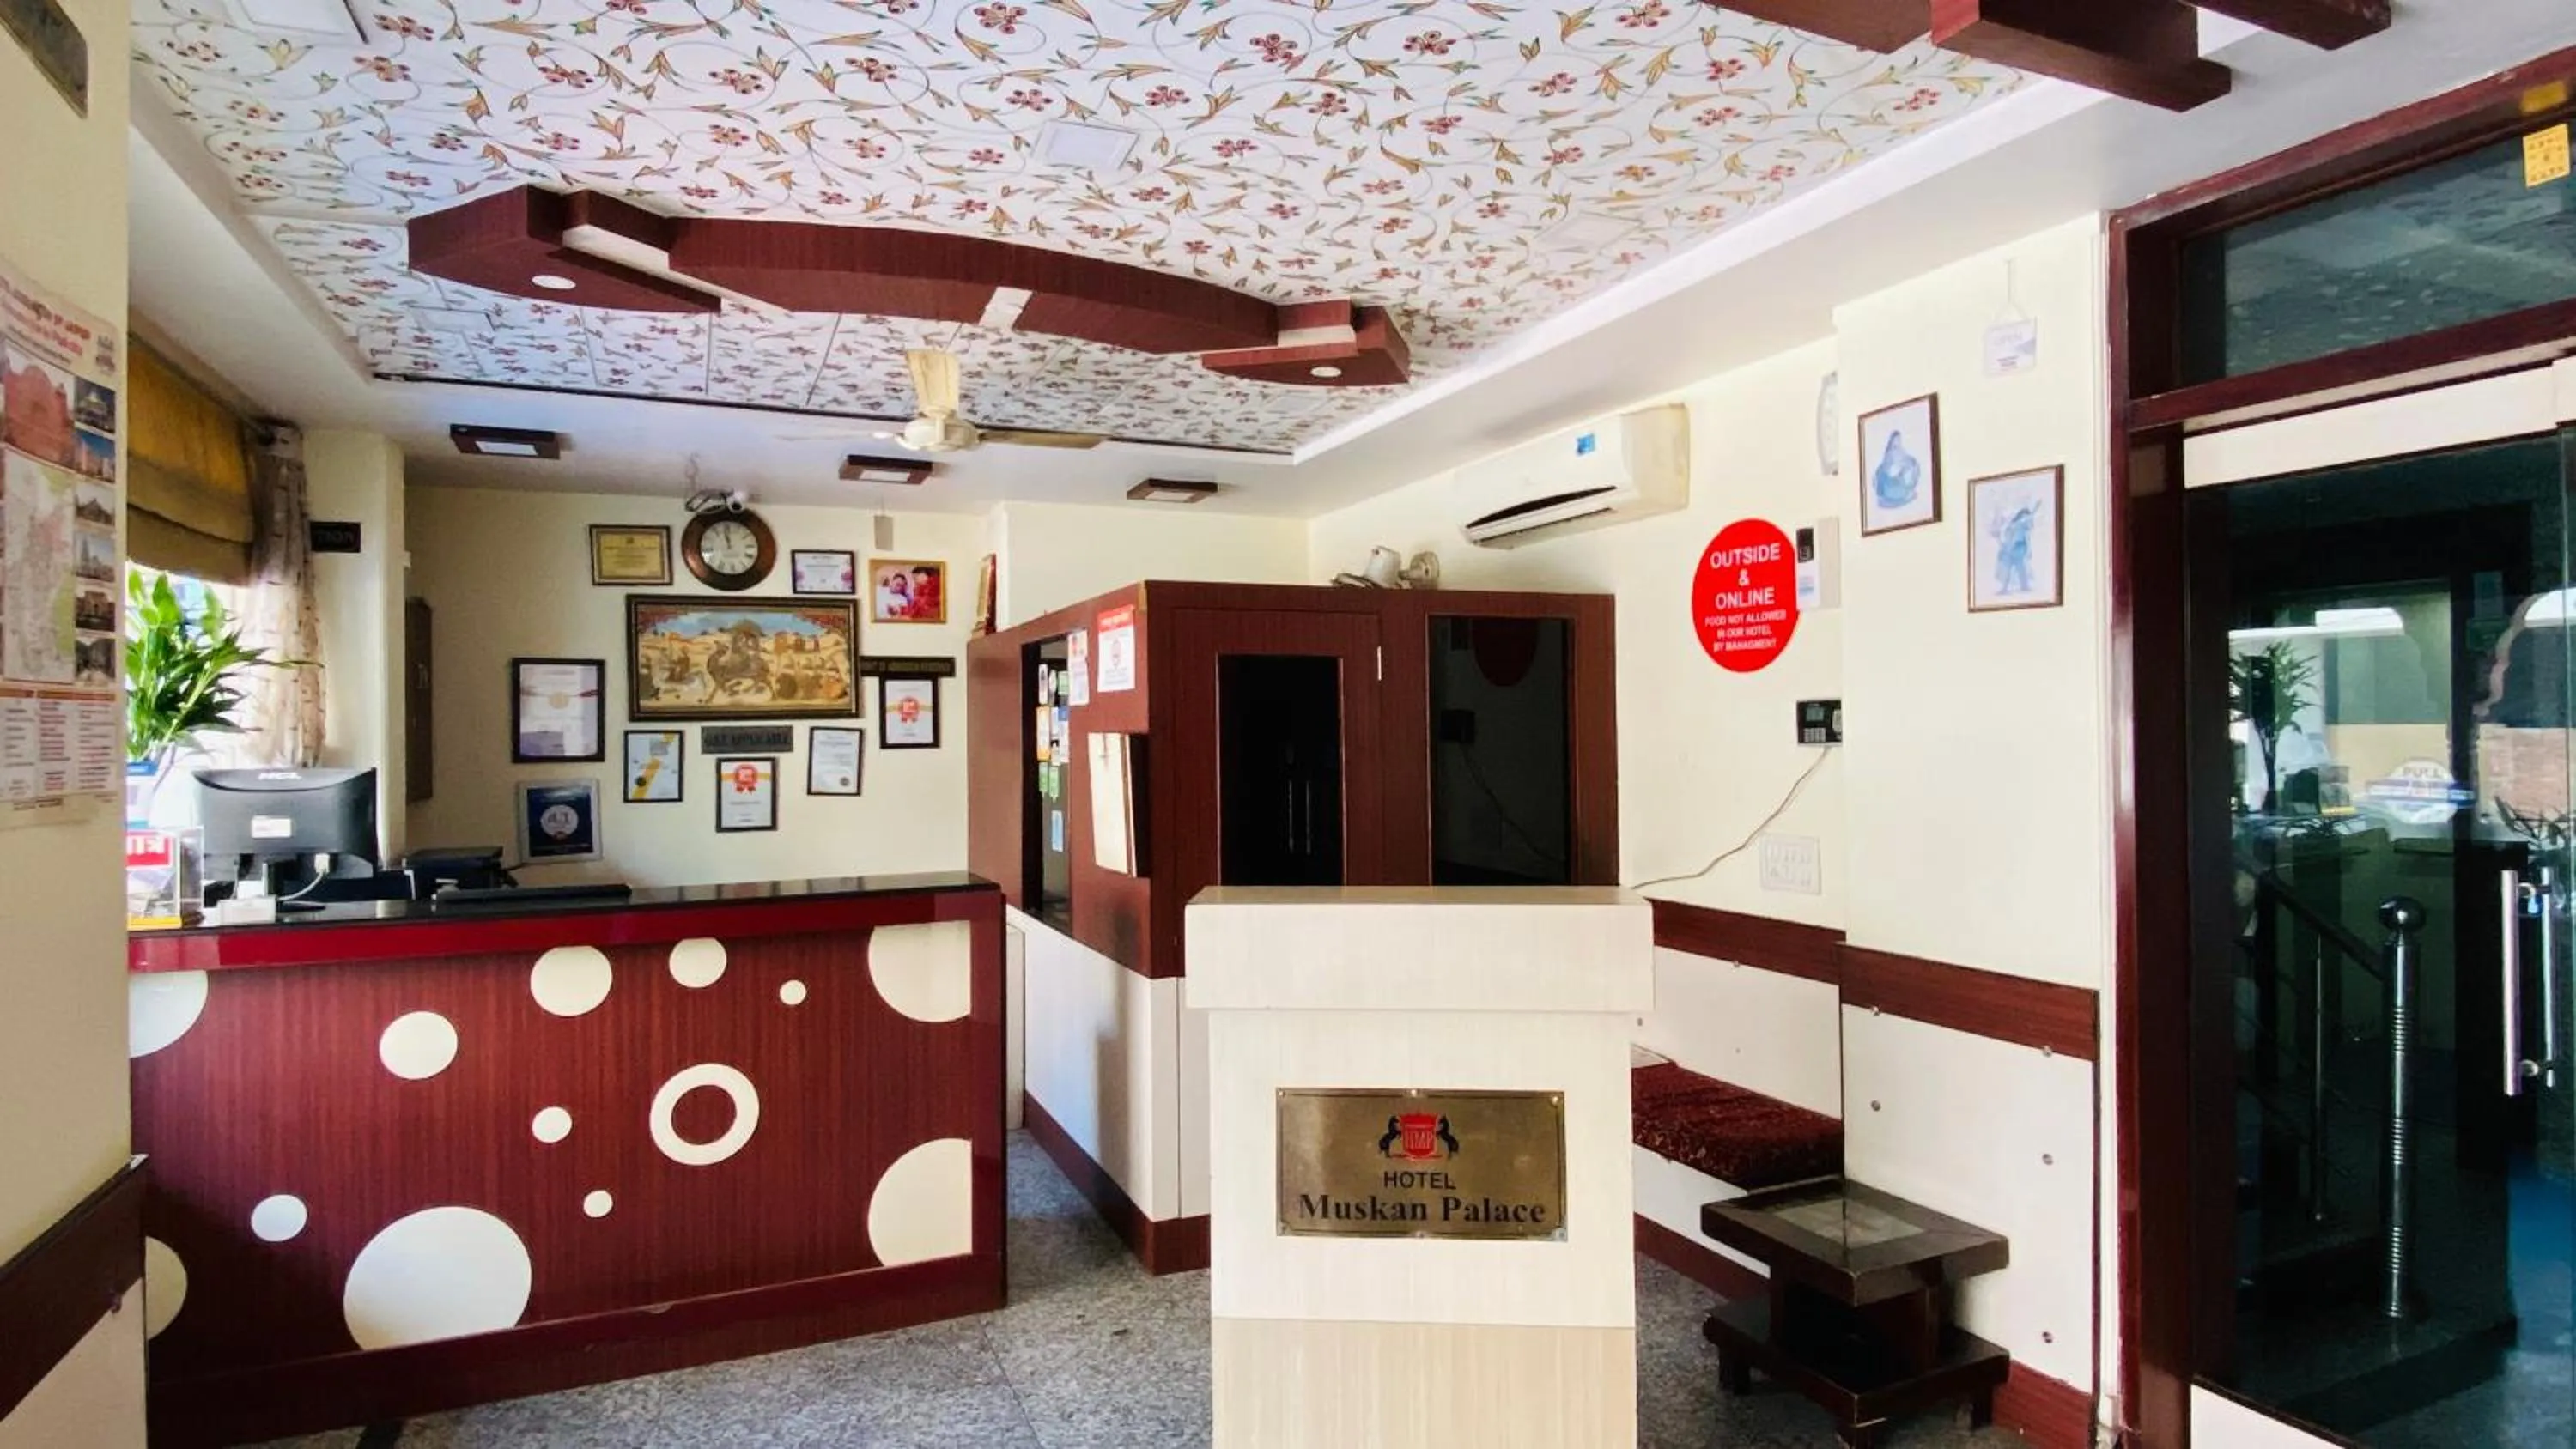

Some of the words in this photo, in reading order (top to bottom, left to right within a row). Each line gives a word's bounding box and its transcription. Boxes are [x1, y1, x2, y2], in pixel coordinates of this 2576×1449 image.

[1710, 543, 1781, 569] OUTSIDE
[1738, 568, 1750, 586] &
[1716, 587, 1775, 610] ONLINE
[1704, 616, 1727, 627] FOOD
[1728, 614, 1744, 625] NOT
[1746, 609, 1786, 623] ALLOWED
[1717, 628, 1725, 639] IN
[1726, 627, 1744, 638] OUR
[1745, 624, 1772, 636] HOTEL
[1713, 641, 1724, 652] BY
[1383, 1171, 1457, 1190] HOTEL
[1299, 1193, 1428, 1222] Muskan
[1442, 1195, 1546, 1223] Palace
